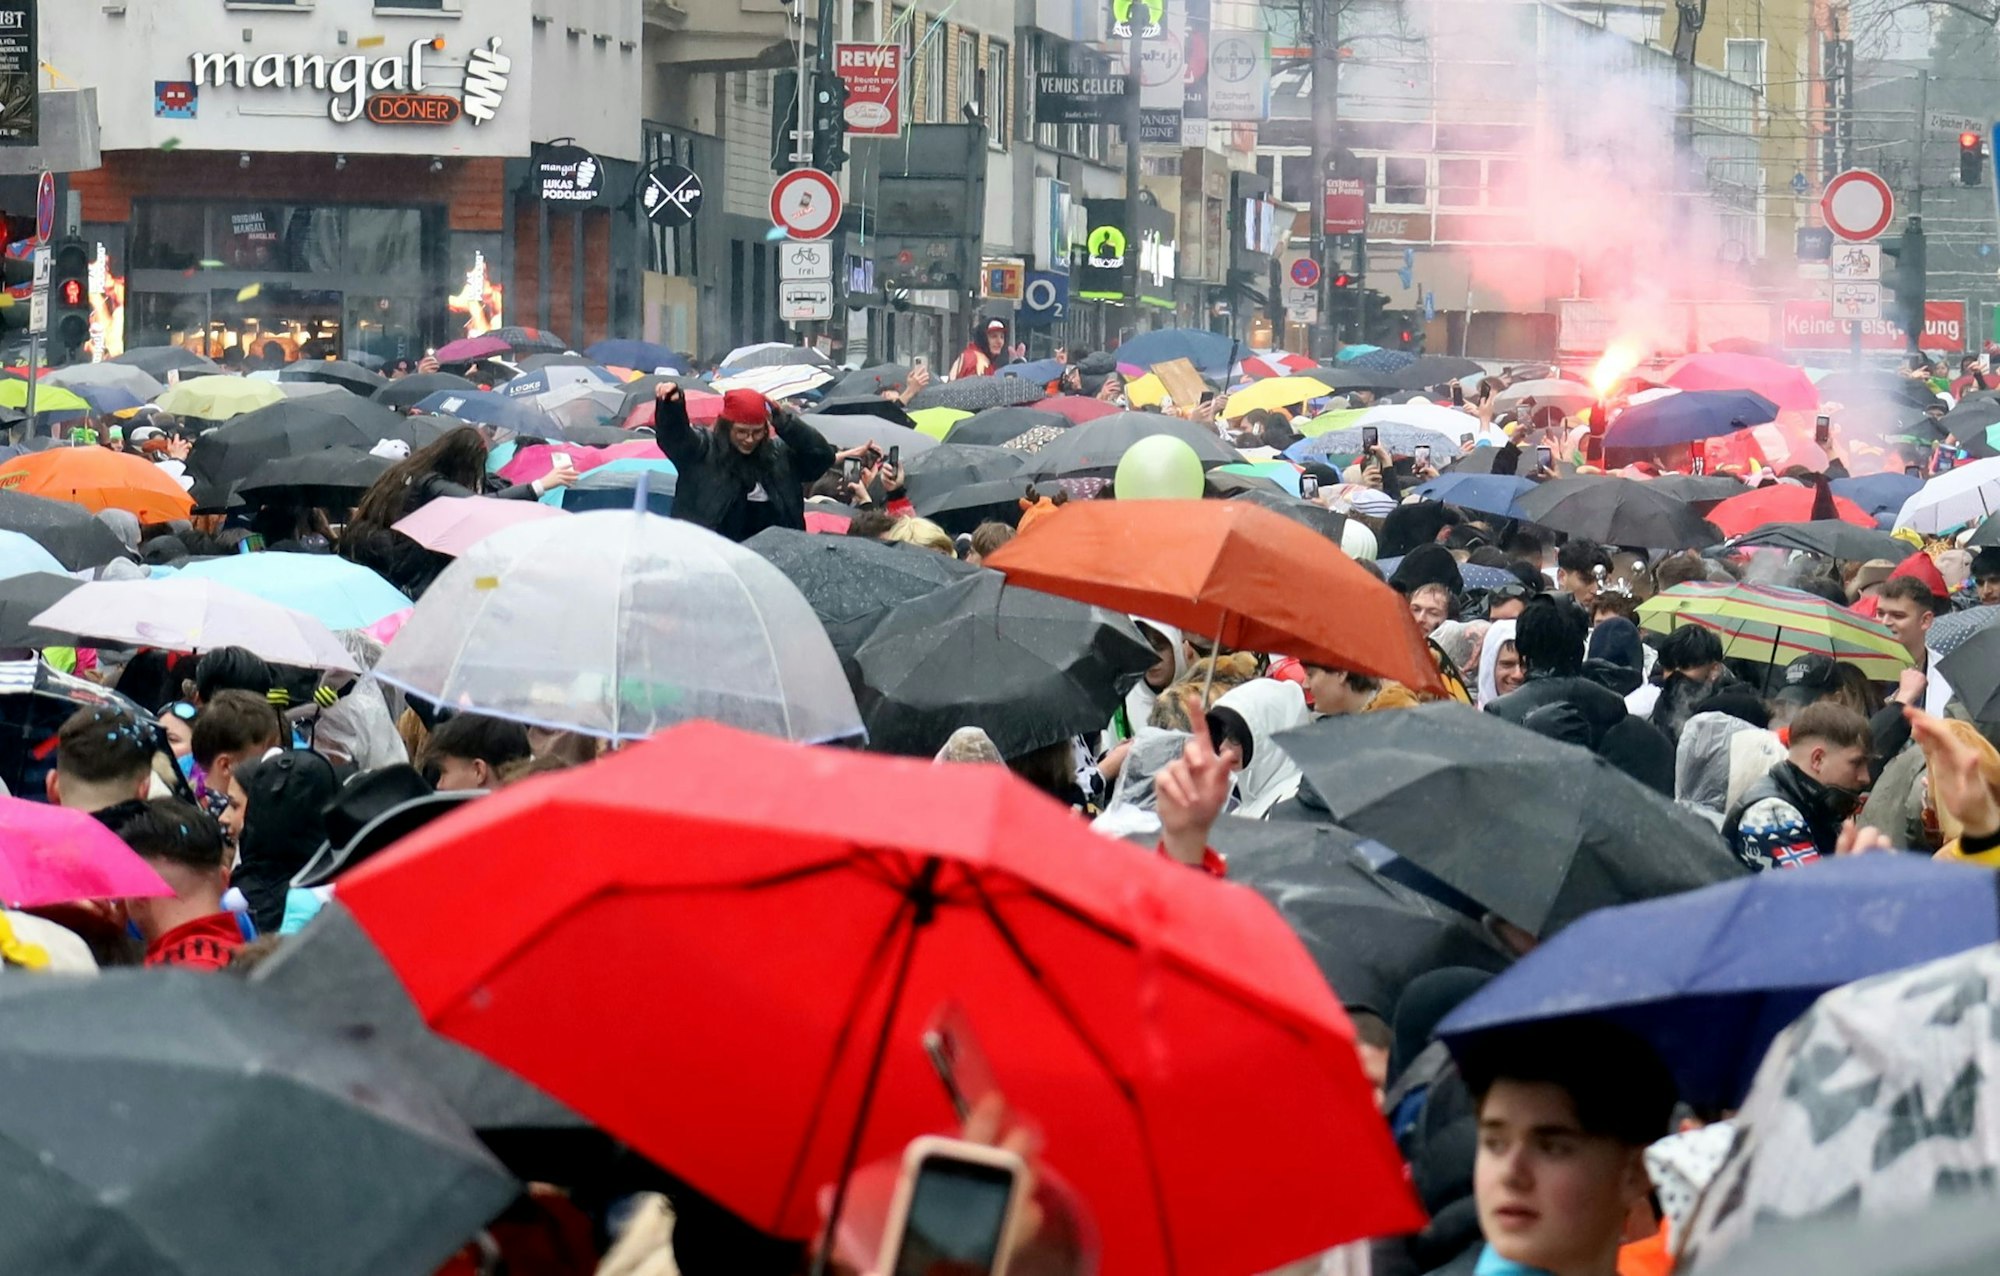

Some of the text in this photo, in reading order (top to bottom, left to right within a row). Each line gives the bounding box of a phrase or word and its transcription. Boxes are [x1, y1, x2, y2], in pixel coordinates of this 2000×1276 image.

[840, 51, 896, 68] REWE
[191, 38, 434, 122] mangal
[1041, 77, 1125, 95] VENUS CELLER
[379, 99, 449, 120] DÖNER
[540, 162, 578, 177] mangal
[542, 179, 574, 190] LUKAS
[798, 267, 815, 275] frei
[1787, 315, 1835, 336] Keine
